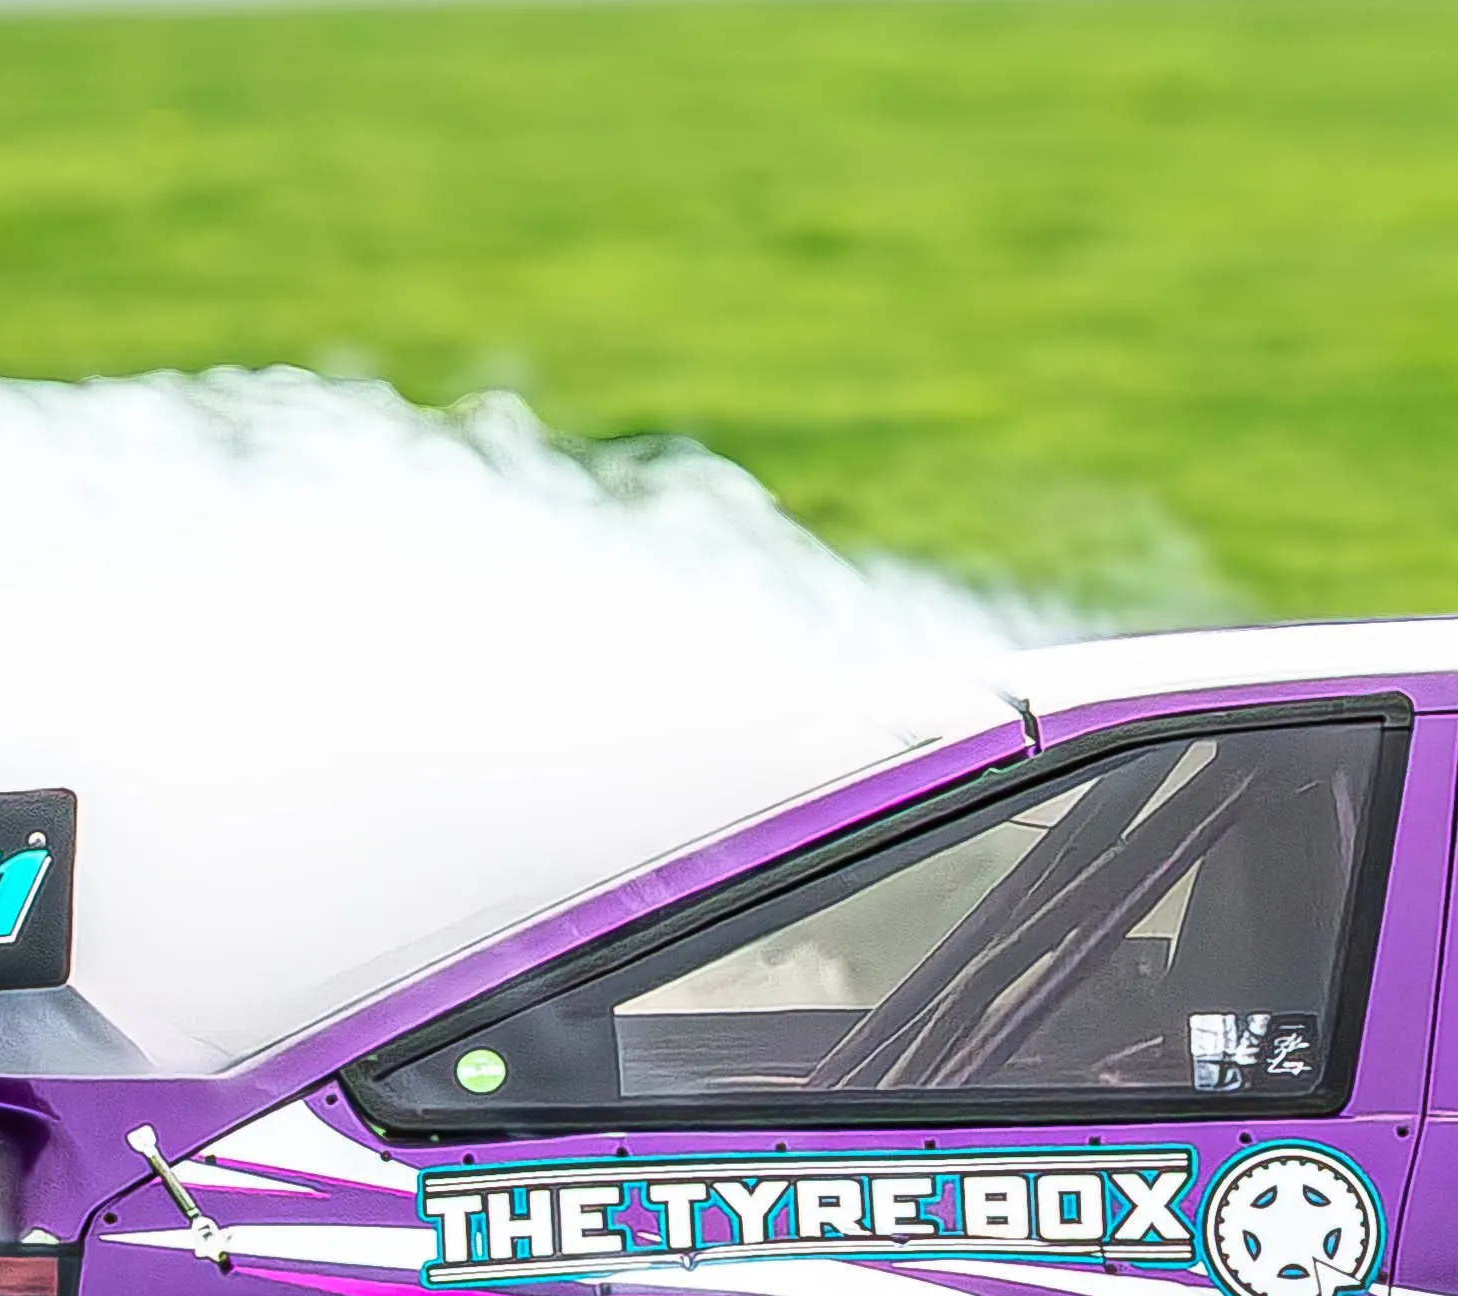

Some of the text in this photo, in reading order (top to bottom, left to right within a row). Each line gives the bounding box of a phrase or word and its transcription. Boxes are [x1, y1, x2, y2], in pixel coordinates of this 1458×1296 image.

[425, 1172, 1192, 1265] THE TYRE BOX
